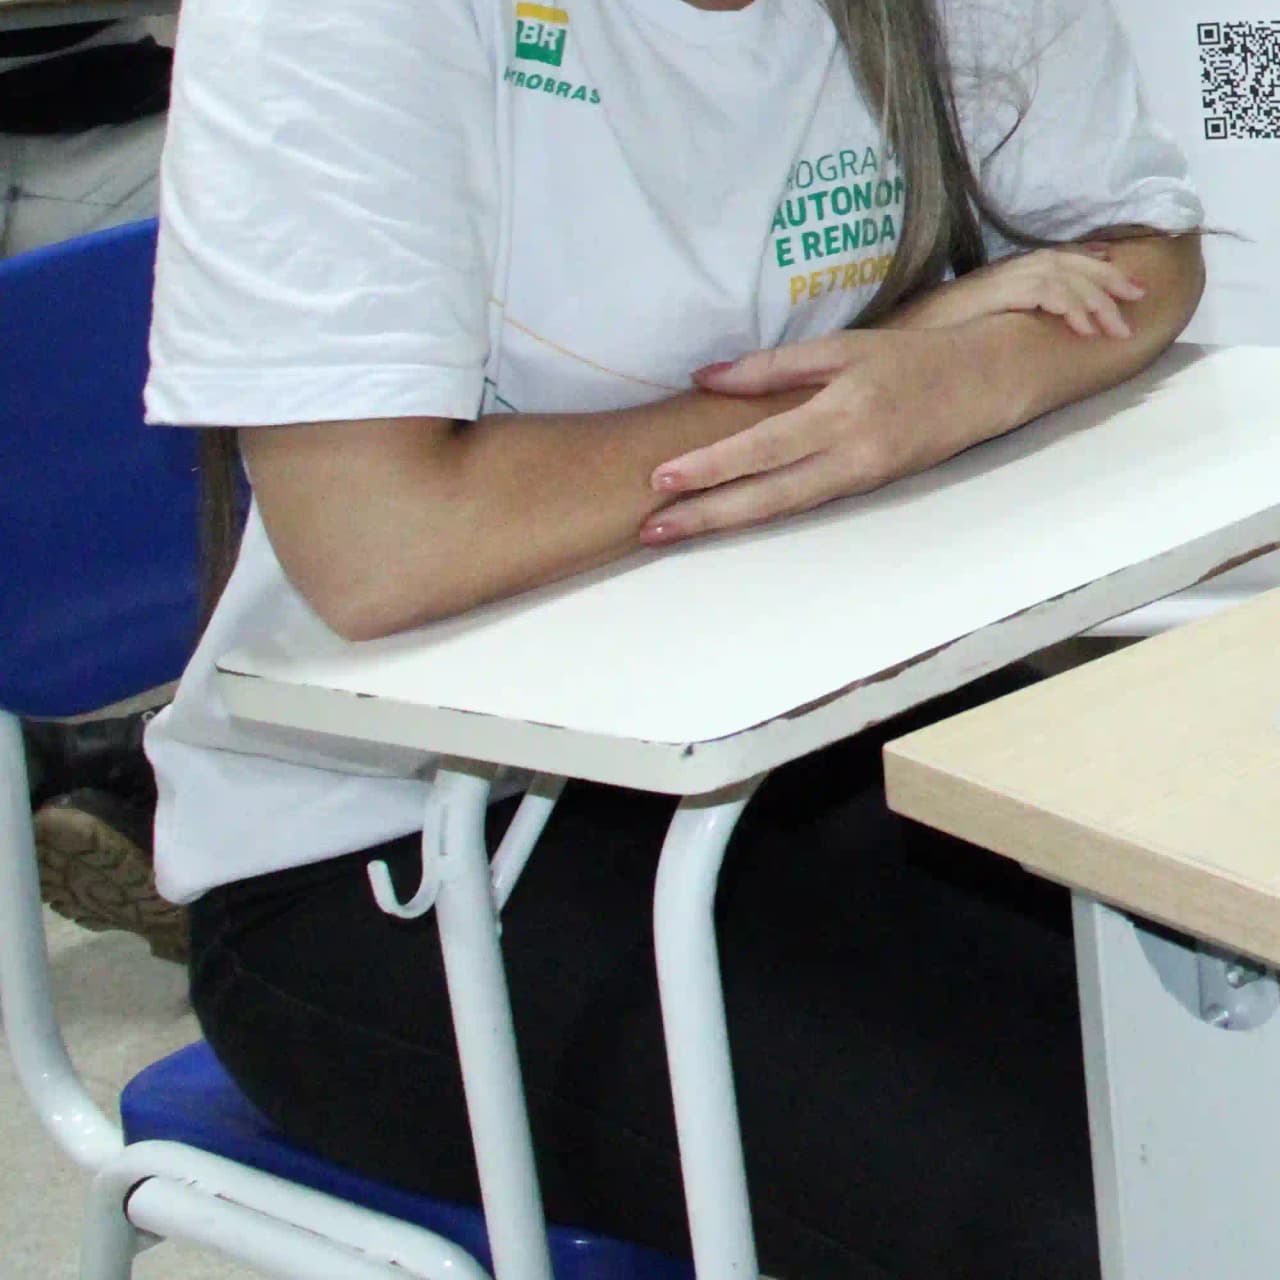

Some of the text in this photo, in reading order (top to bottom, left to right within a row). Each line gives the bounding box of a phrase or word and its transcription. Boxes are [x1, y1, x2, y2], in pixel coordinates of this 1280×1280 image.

[519, 21, 560, 51] BR
[775, 214, 896, 267] E RENDA
